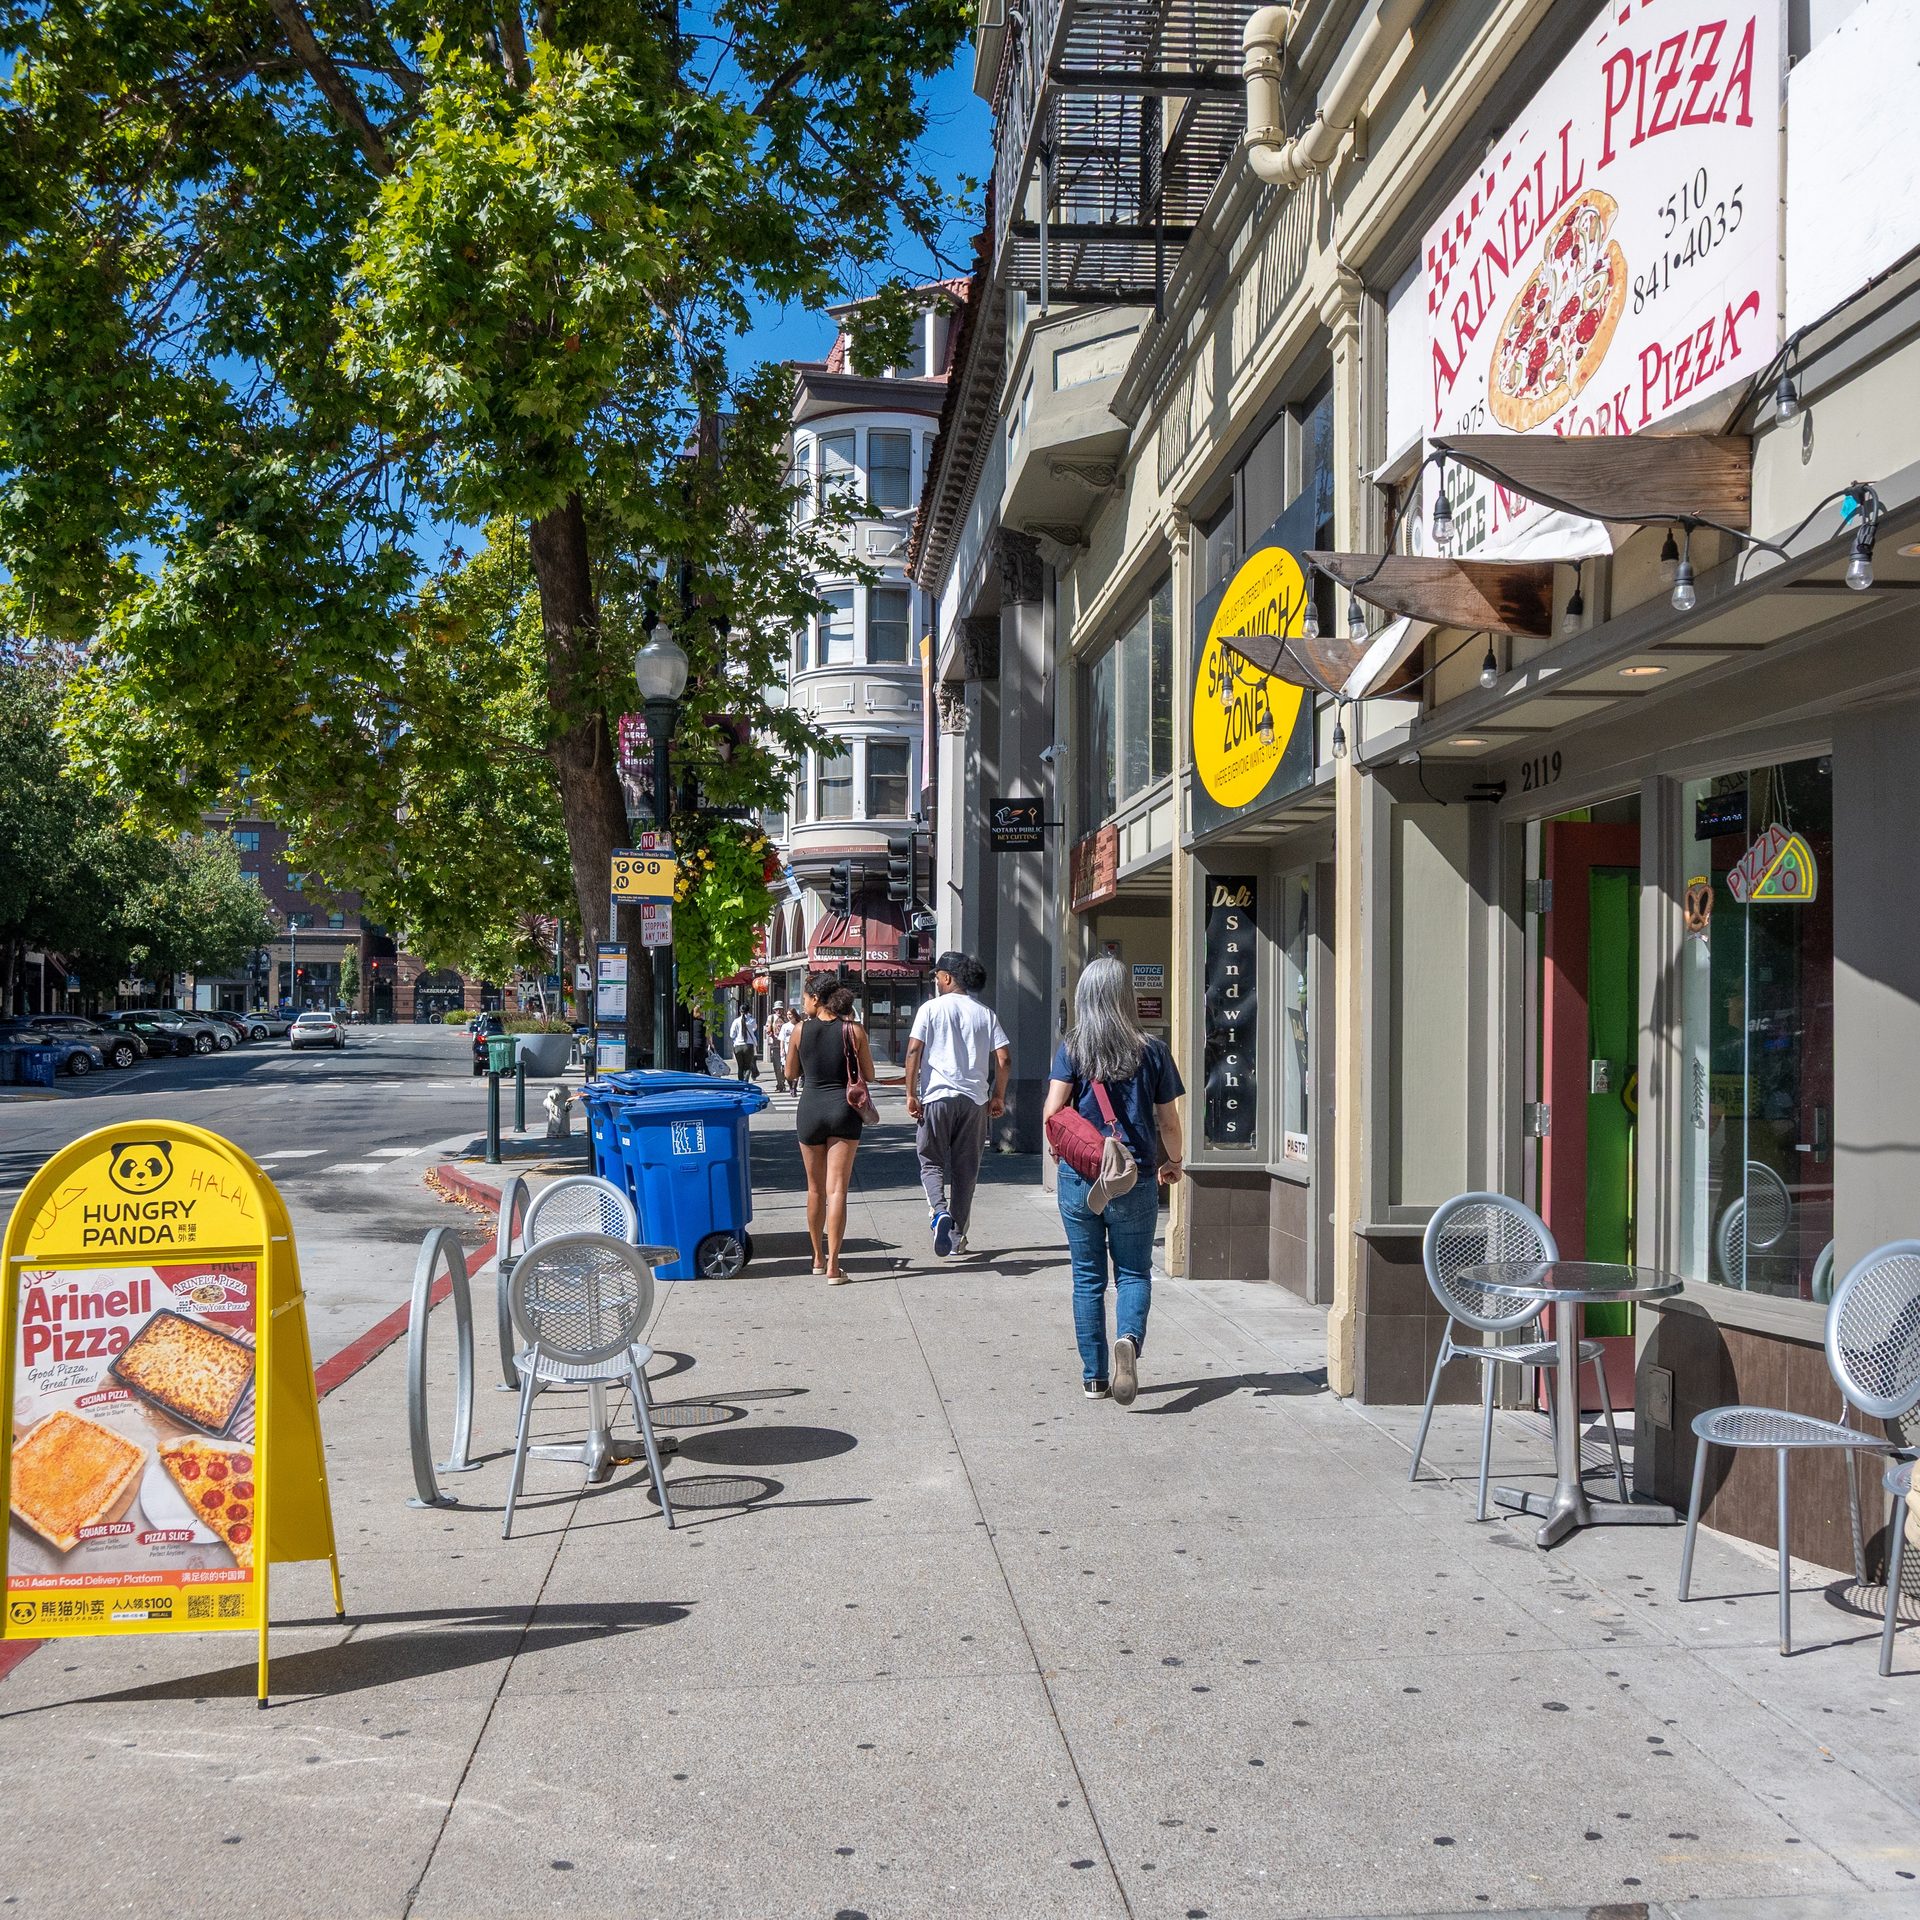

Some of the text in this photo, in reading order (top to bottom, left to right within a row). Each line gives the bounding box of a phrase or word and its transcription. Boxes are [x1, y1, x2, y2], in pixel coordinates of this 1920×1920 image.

[1664, 167, 1707, 239] 510
[1432, 14, 1756, 432] ARINELL PIZZA
[1457, 398, 1485, 435] 1975
[1492, 481, 1535, 534] NE
[1639, 290, 1760, 422] PIZZA
[1438, 495, 1485, 559] YLE
[1224, 685, 1264, 753] ZONE
[624, 731, 649, 739] BERK
[1522, 751, 1561, 792] 2119
[643, 835, 654, 848] NO
[620, 862, 658, 873] P C H
[1728, 827, 1786, 898] PIZZA
[618, 878, 627, 887] N
[1212, 884, 1252, 908] Deli
[643, 907, 654, 918] NO
[921, 916, 935, 926] ONE
[645, 922, 669, 931] STOPPING
[645, 931, 669, 941] ANY TIME
[817, 947, 842, 955] Addison
[844, 948, 889, 963] Exress
[878, 969, 908, 977] 2045
[1134, 966, 1162, 974] NOTICE
[1223, 914, 1241, 1133] Sandwiches
[189, 1168, 255, 1219] HALAL
[84, 1200, 197, 1224] HUNGRY
[83, 1224, 175, 1247] PANDA
[173, 1275, 247, 1295] ARINELL PIZZA
[22, 1279, 152, 1325] Arinell
[227, 1303, 250, 1311] PIZZA
[22, 1323, 131, 1368] Pizza
[28, 1363, 88, 1382] Good Pizza,
[40, 1372, 99, 1392] Great Times!
[107, 1390, 129, 1400] PIZZA
[79, 1523, 131, 1539] SQUARE PIZZA
[144, 1531, 190, 1544] PIZZA SLICE
[11, 1574, 163, 1588] No.1 Asian Food Delivery Platform
[41, 1600, 105, 1617] 熊猫外卖
[112, 1597, 173, 1610] 人人领$100
